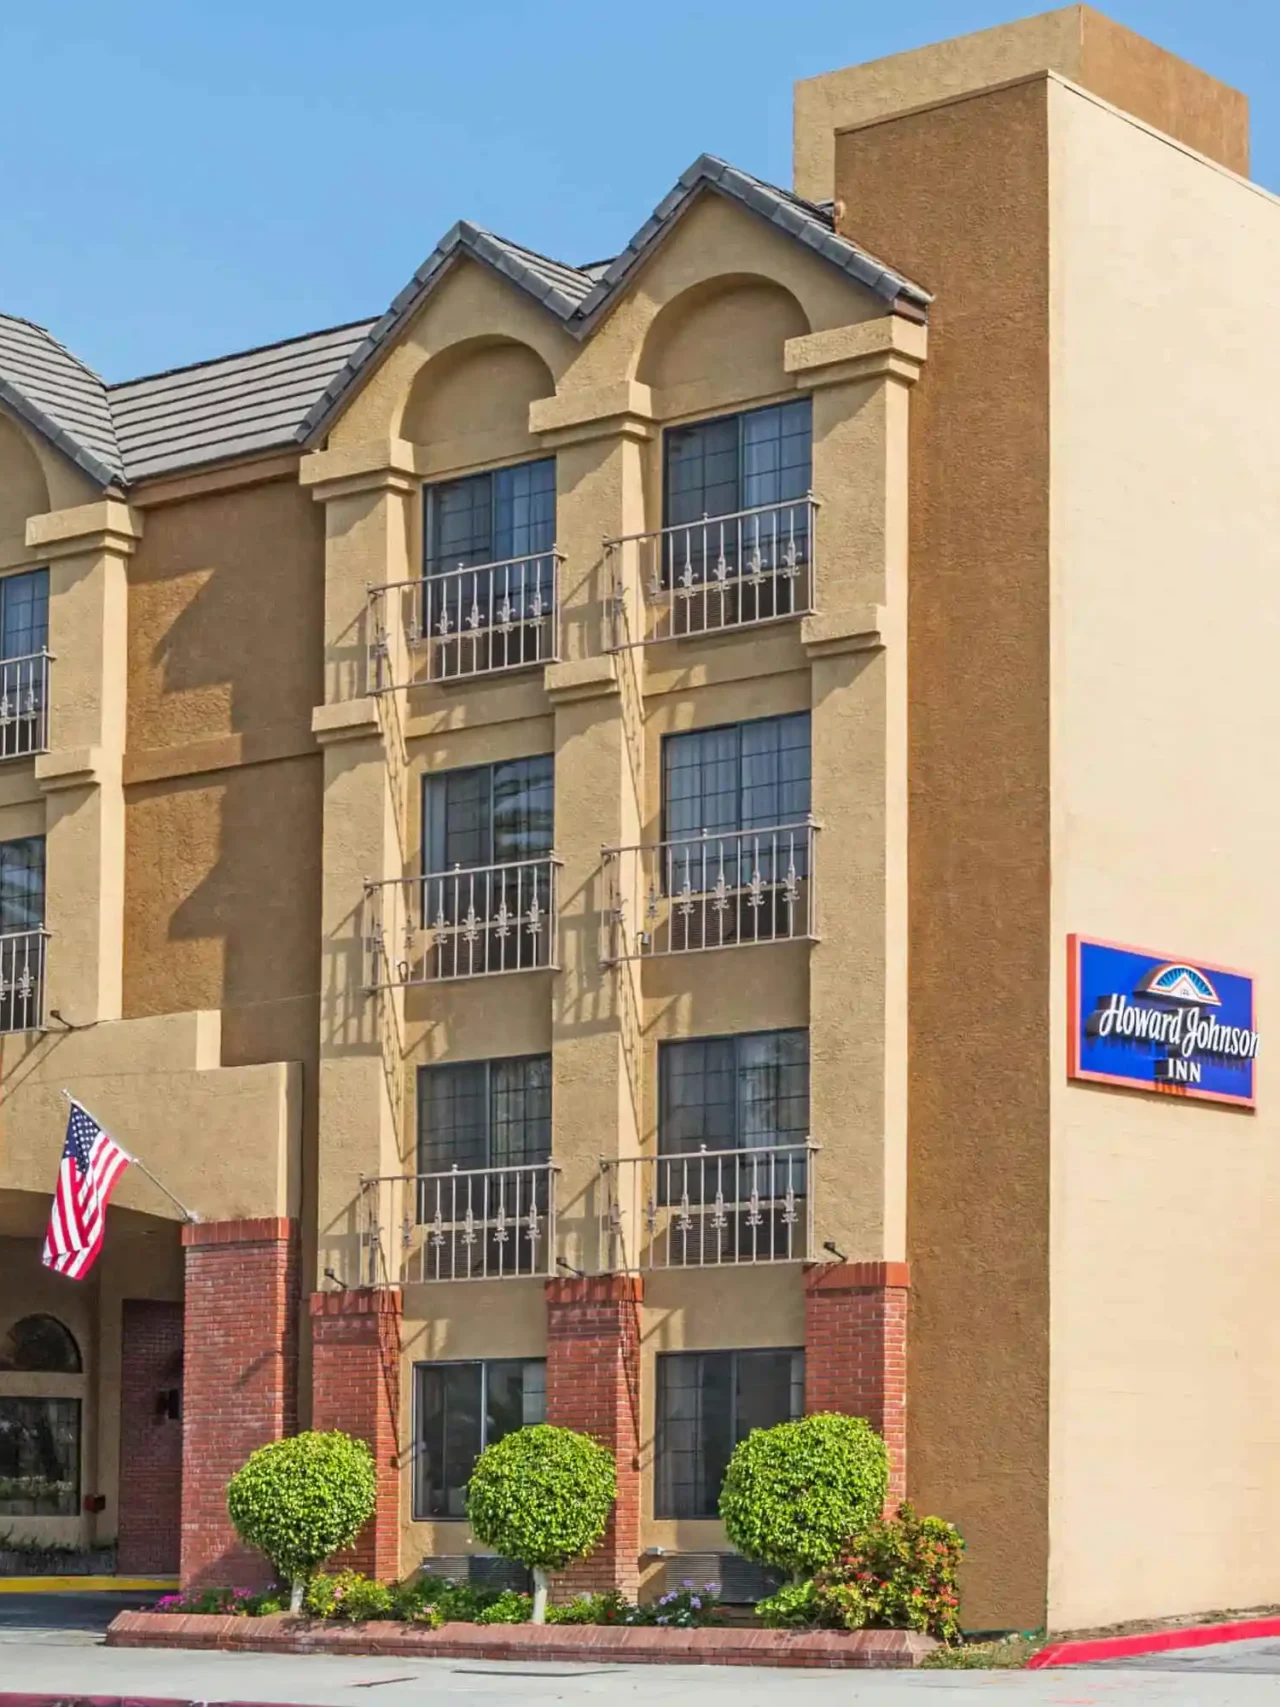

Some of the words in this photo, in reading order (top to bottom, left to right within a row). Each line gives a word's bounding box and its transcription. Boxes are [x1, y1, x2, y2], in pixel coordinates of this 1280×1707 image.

[1099, 992, 1184, 1045] Howard
[1182, 1006, 1261, 1058] Johnson
[1168, 1057, 1201, 1083] INN
